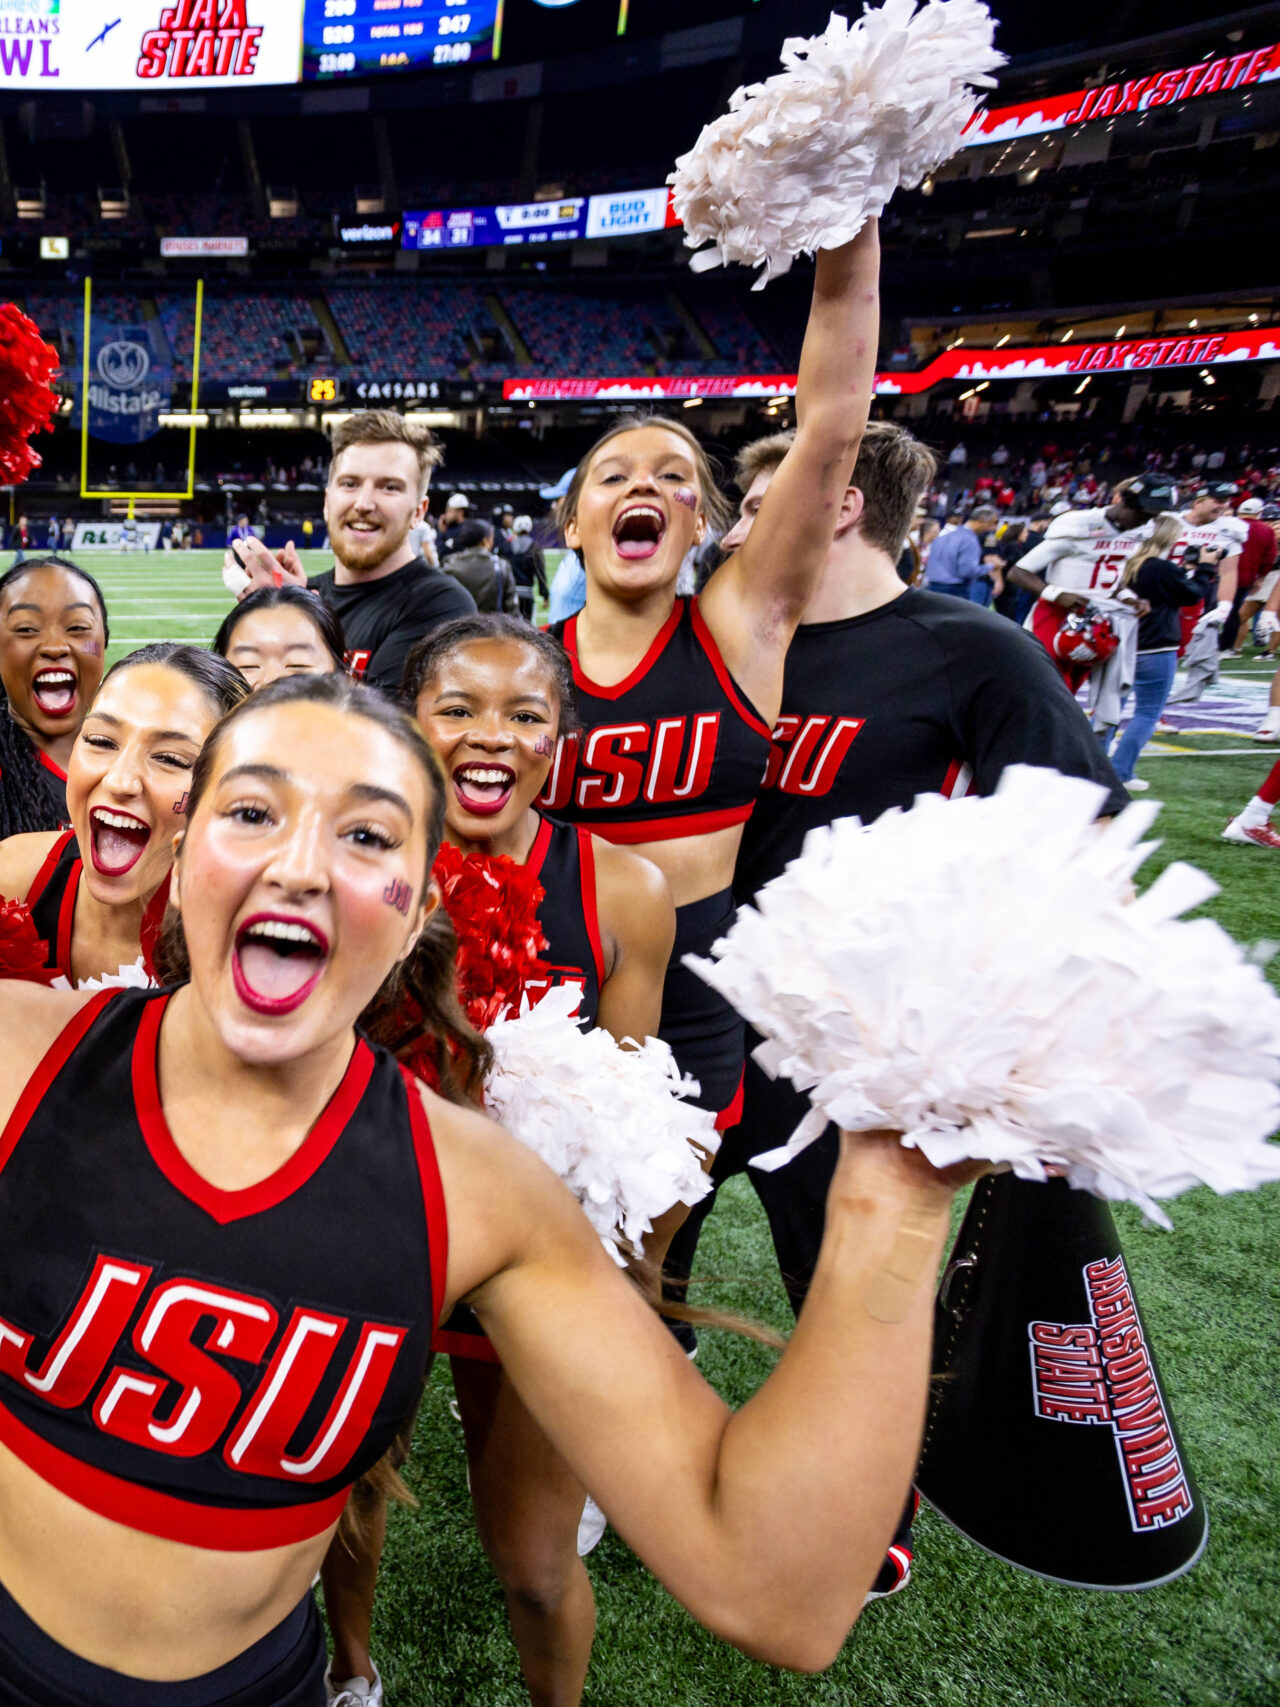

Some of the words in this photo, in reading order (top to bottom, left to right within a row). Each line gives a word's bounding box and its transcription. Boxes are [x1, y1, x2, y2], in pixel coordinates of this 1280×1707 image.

[160, 0, 248, 29] JAX
[136, 27, 264, 78] STATE
[1064, 76, 1150, 125] JAX
[1147, 45, 1276, 106] STATE
[601, 212, 650, 228] LIGHT
[609, 200, 646, 213] BUD
[341, 224, 394, 242] verizon
[1067, 344, 1131, 373] JAX
[1131, 336, 1225, 368] STATE
[87, 384, 162, 415] Allstate
[356, 382, 440, 399] CAESARS
[1088, 555, 1126, 589] 15
[536, 712, 721, 809] JSU
[1030, 1322, 1112, 1423] STATE
[1084, 1256, 1192, 1531] JACKSONVILLE
